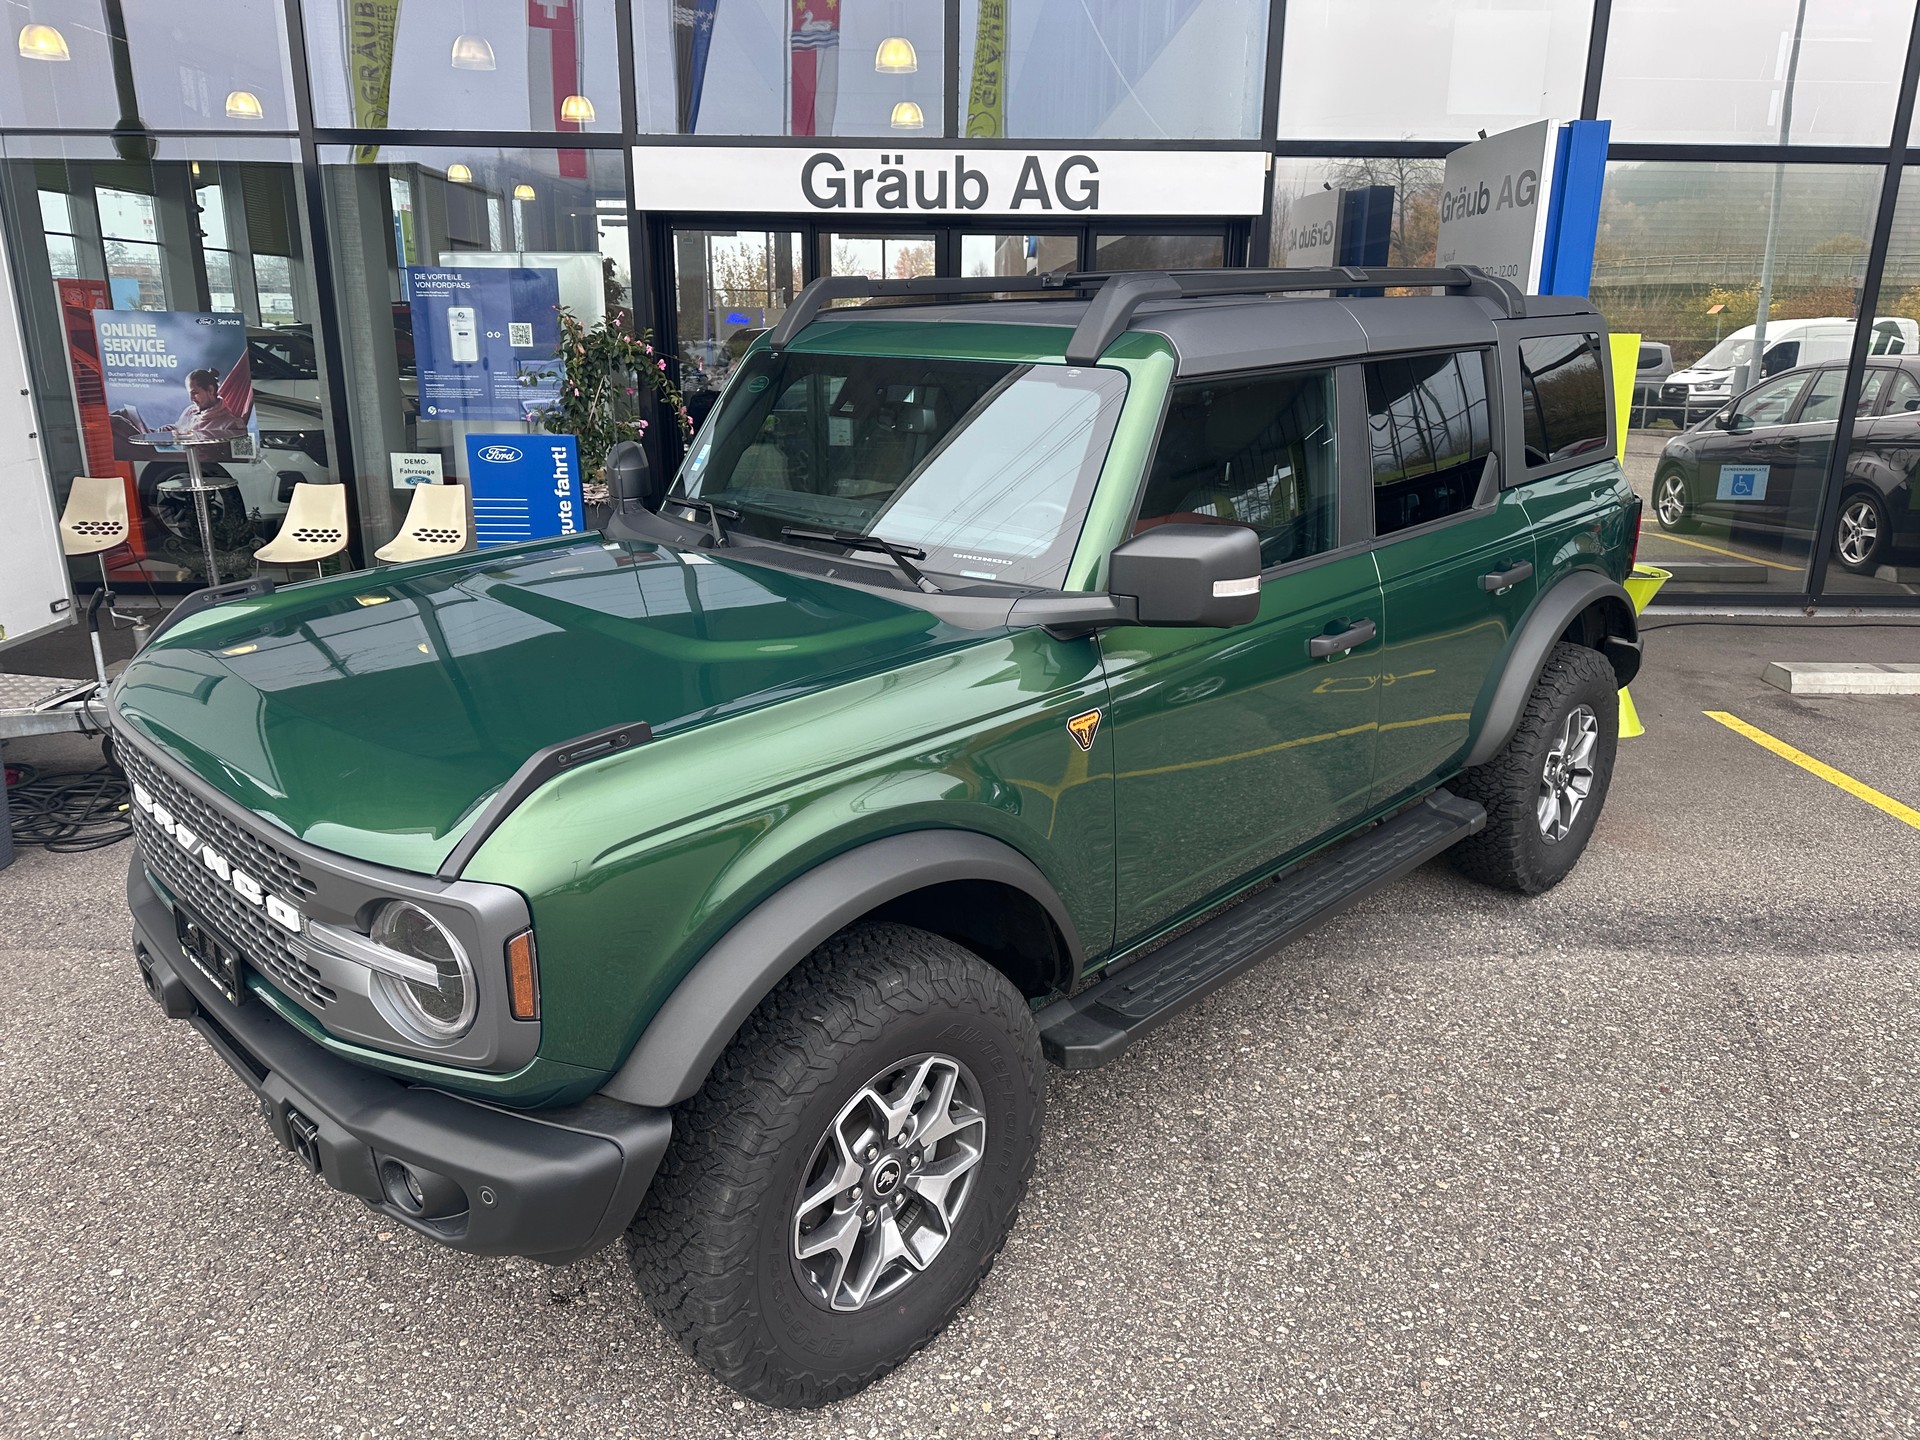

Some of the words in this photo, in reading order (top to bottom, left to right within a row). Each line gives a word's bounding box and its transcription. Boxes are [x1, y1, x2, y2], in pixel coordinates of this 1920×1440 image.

[351, 2, 380, 105] GRÄUB
[801, 152, 989, 209] Gräub
[1009, 155, 1100, 211] AG
[1441, 181, 1491, 223] Gräub
[1495, 169, 1537, 211] AG
[432, 281, 471, 289] FORDPASS
[217, 318, 241, 326] Service
[101, 322, 157, 338] ONLINE
[103, 338, 166, 353] SERVICE
[105, 353, 178, 368] BUCHUNG
[485, 447, 515, 461] Ford
[399, 467, 435, 476] Fahrzeuge
[551, 446, 571, 498] fahrt!
[953, 553, 1013, 566] BRONCO
[134, 783, 301, 932] BRONCO
